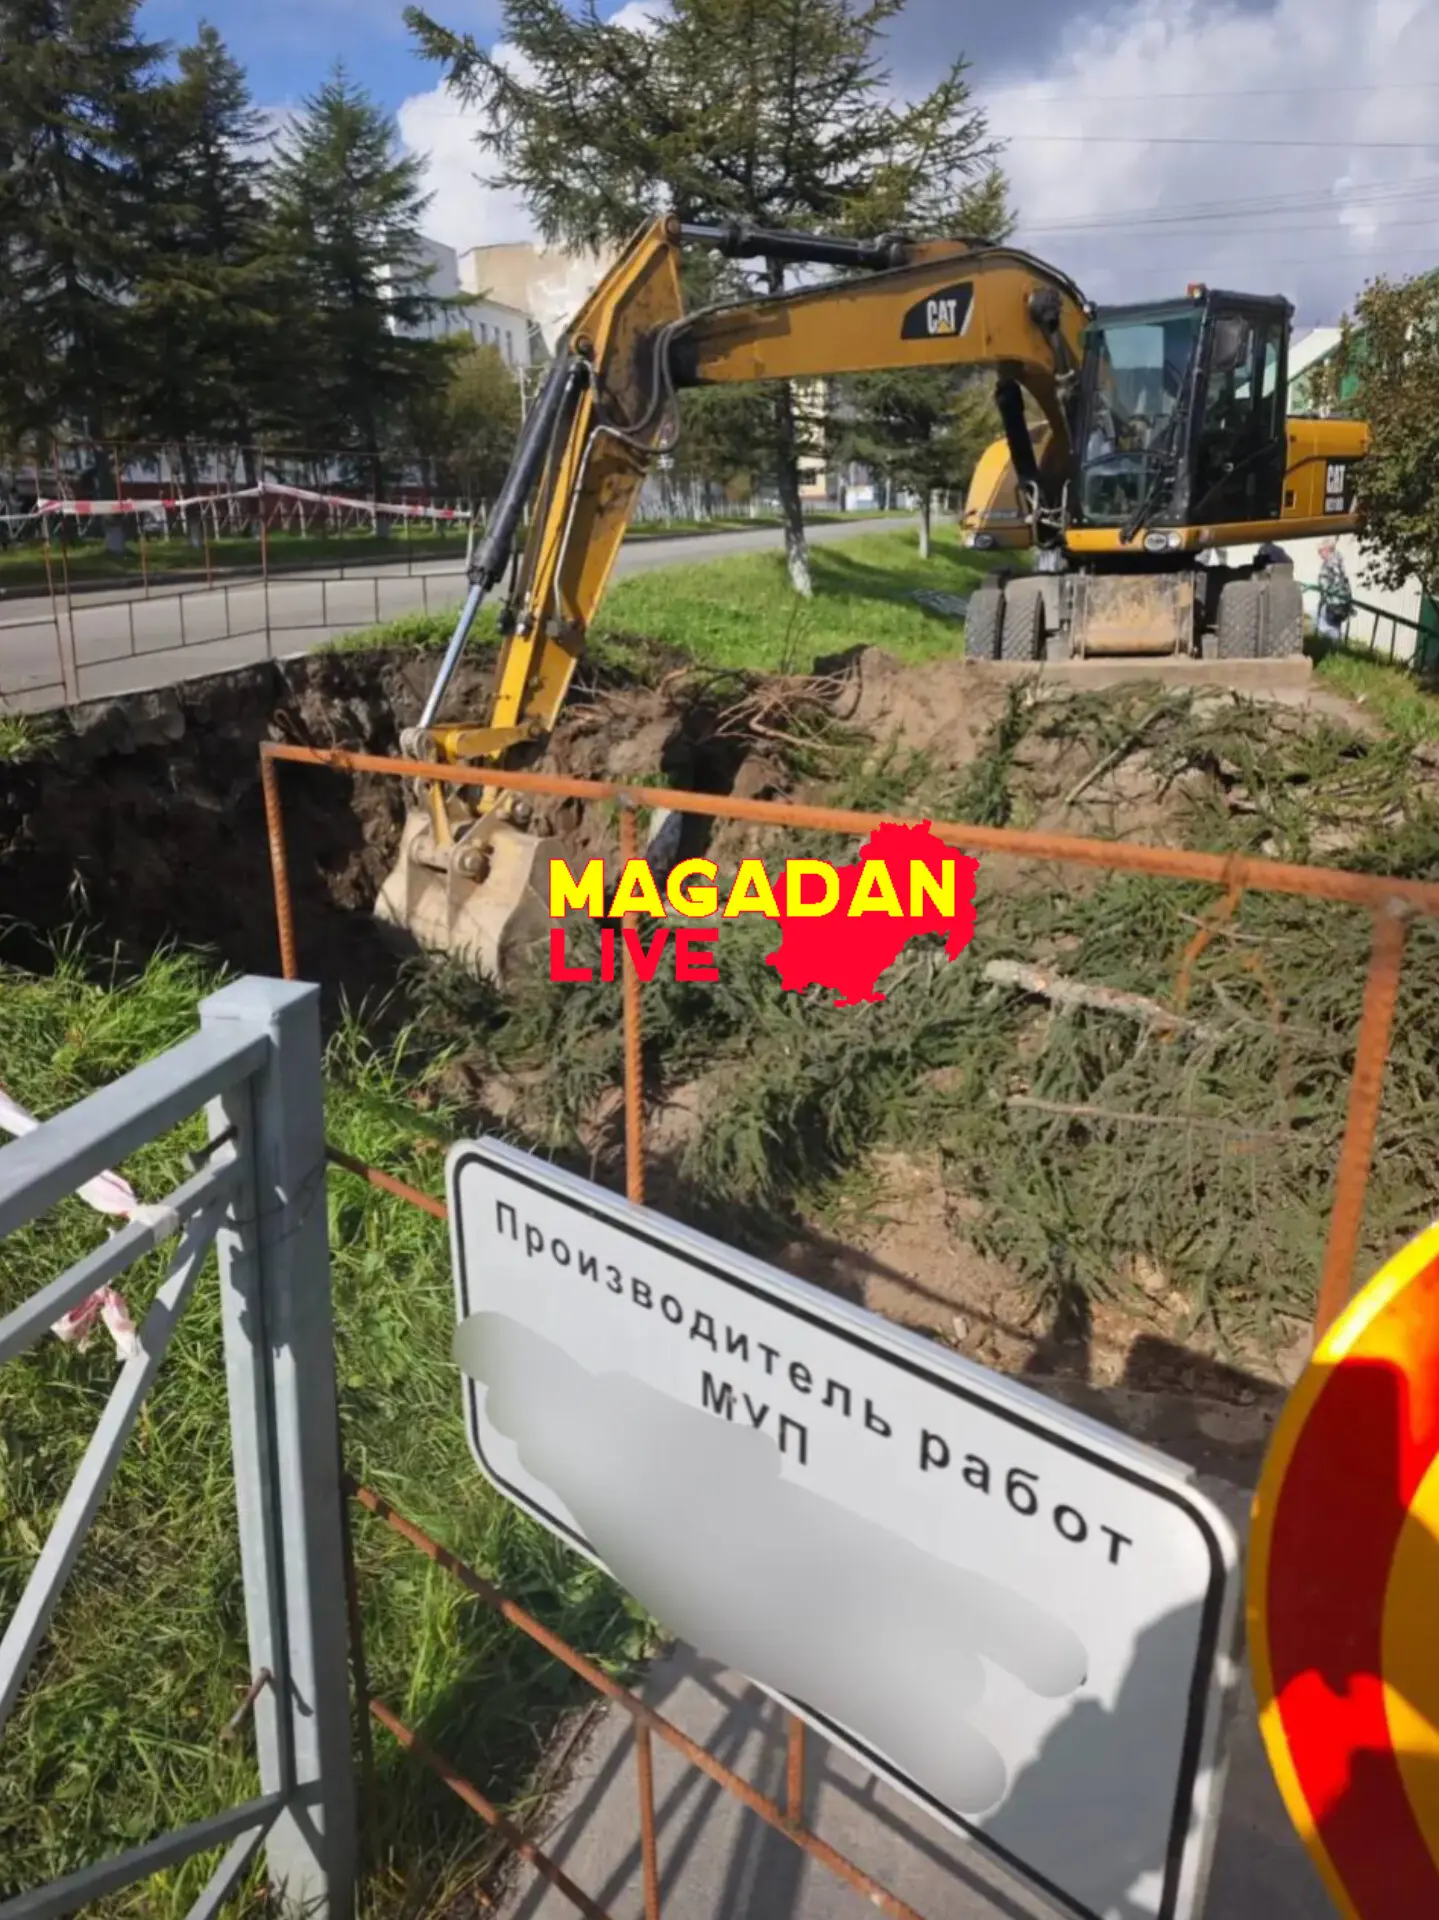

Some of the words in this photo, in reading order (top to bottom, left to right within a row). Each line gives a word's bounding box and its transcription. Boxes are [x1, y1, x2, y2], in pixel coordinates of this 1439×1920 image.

[926, 299, 957, 334] CAT
[496, 1199, 893, 1439] Производитель
[920, 1428, 1133, 1566] работ
[702, 1369, 808, 1466] МУП
